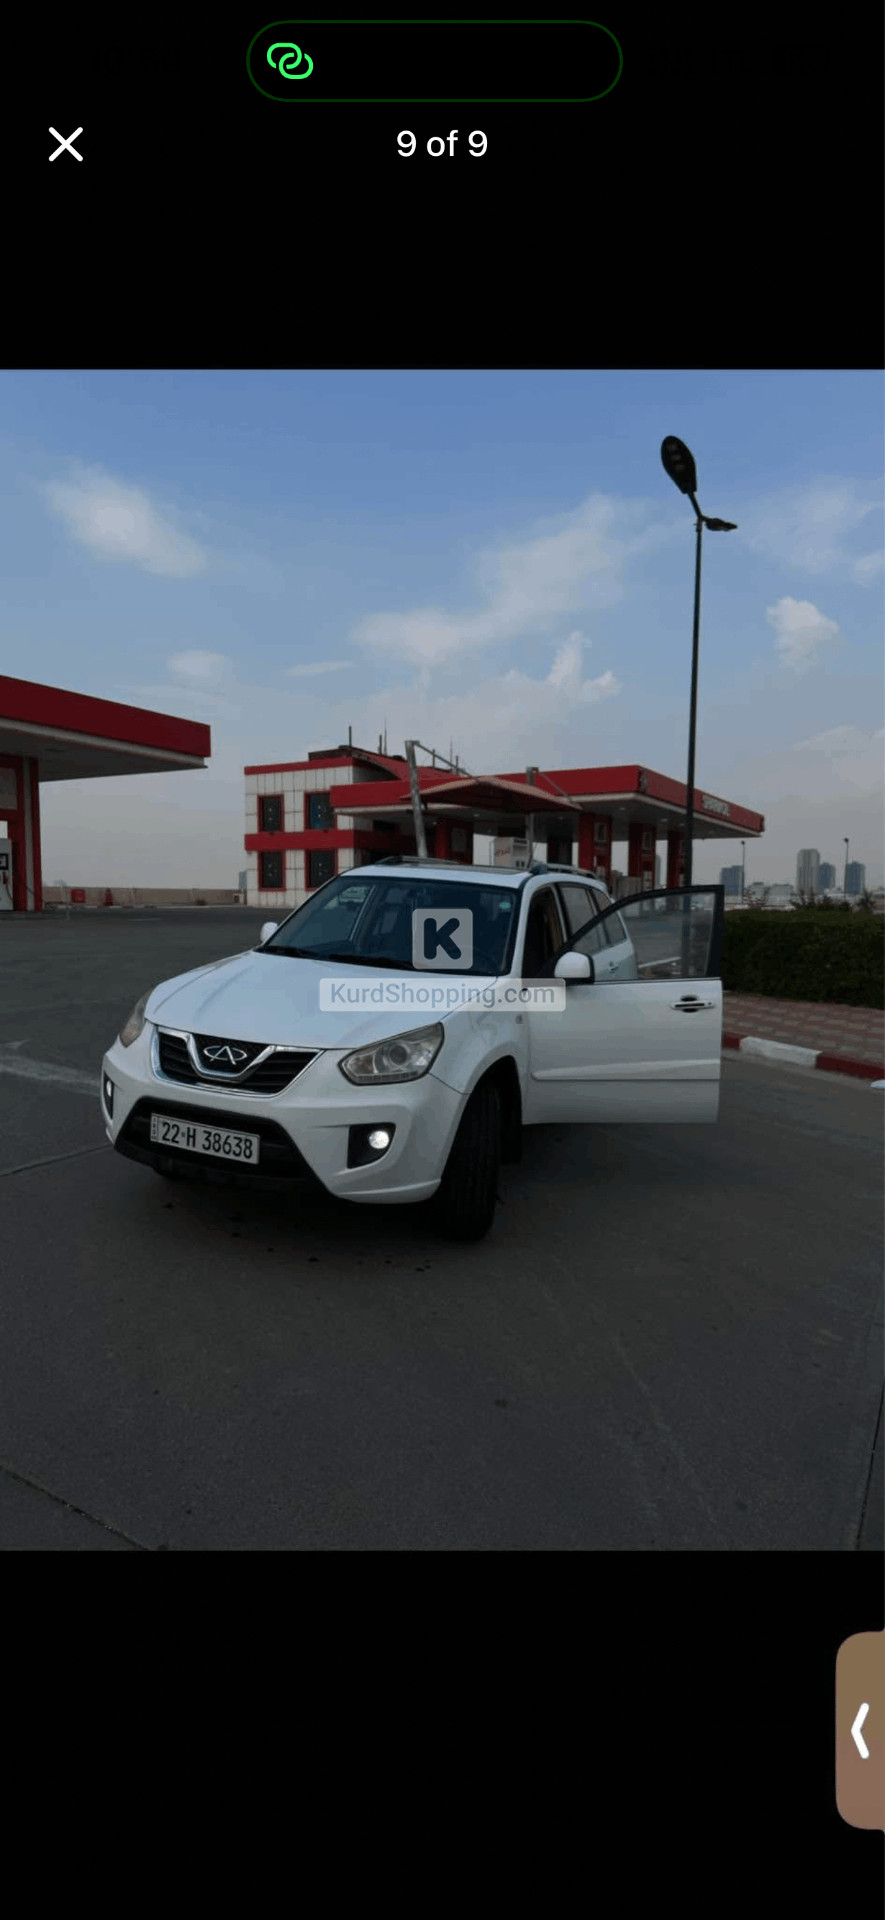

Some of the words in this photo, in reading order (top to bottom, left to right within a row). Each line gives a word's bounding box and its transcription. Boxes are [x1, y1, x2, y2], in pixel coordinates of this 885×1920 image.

[162, 1122, 180, 1144] 22
[186, 1126, 196, 1148] H
[202, 1130, 253, 1159] 38638
